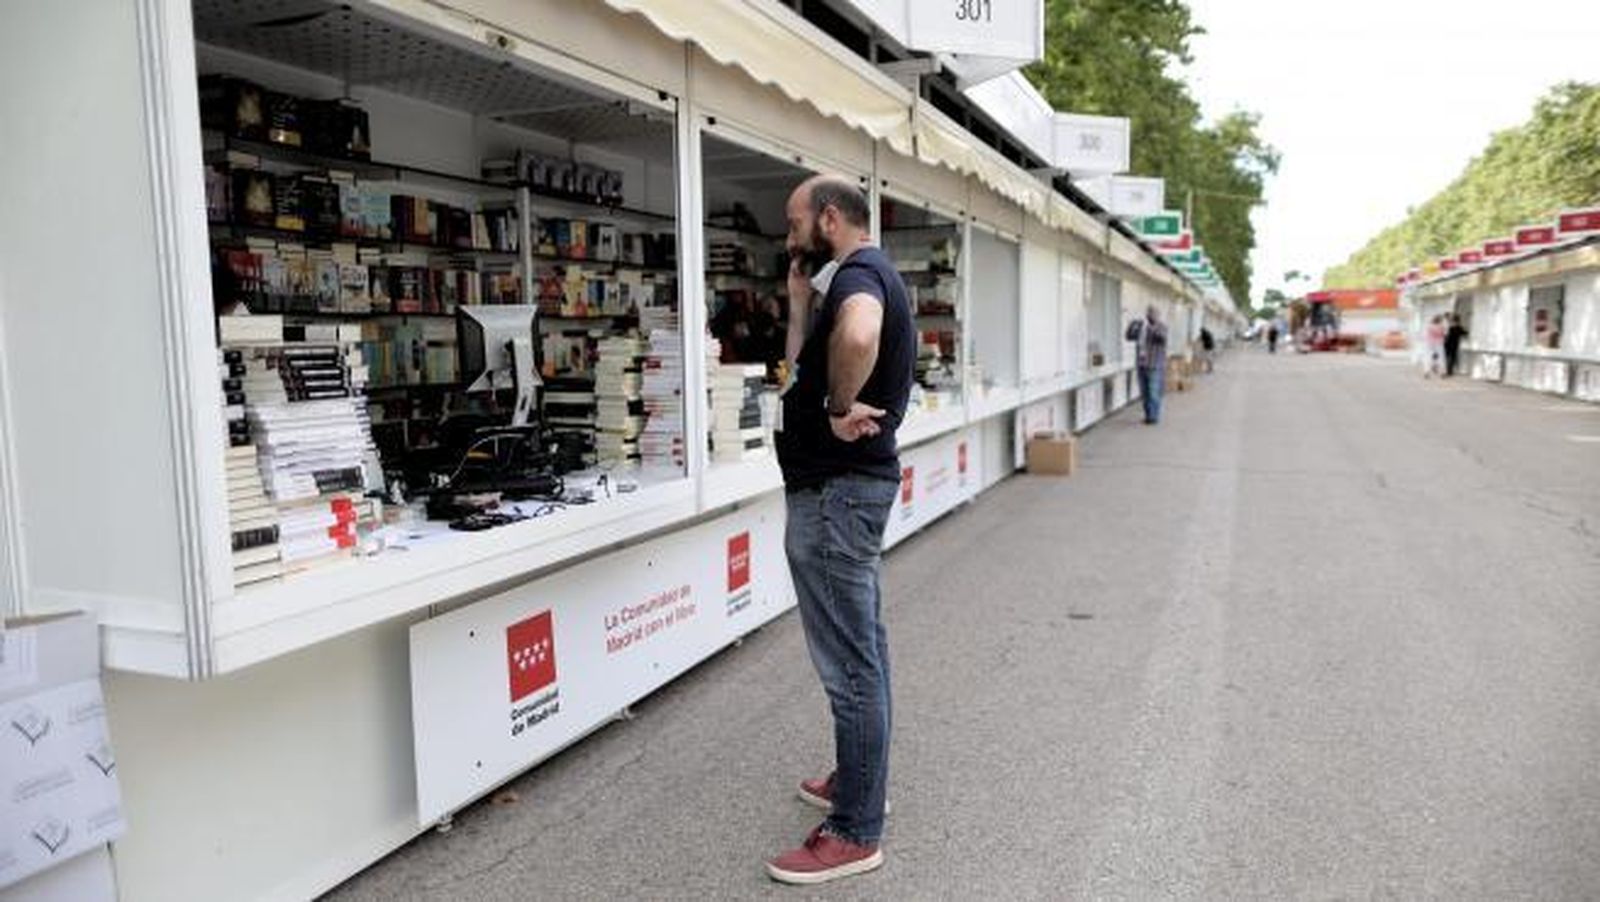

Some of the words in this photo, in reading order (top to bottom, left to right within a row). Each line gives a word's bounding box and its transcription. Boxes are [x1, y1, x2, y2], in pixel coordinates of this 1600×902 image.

[955, 0, 991, 22] 301
[604, 614, 618, 631] La
[606, 625, 642, 653] Madrid
[645, 617, 664, 636] con
[511, 723, 525, 736] de
[527, 702, 559, 728] Madrid
